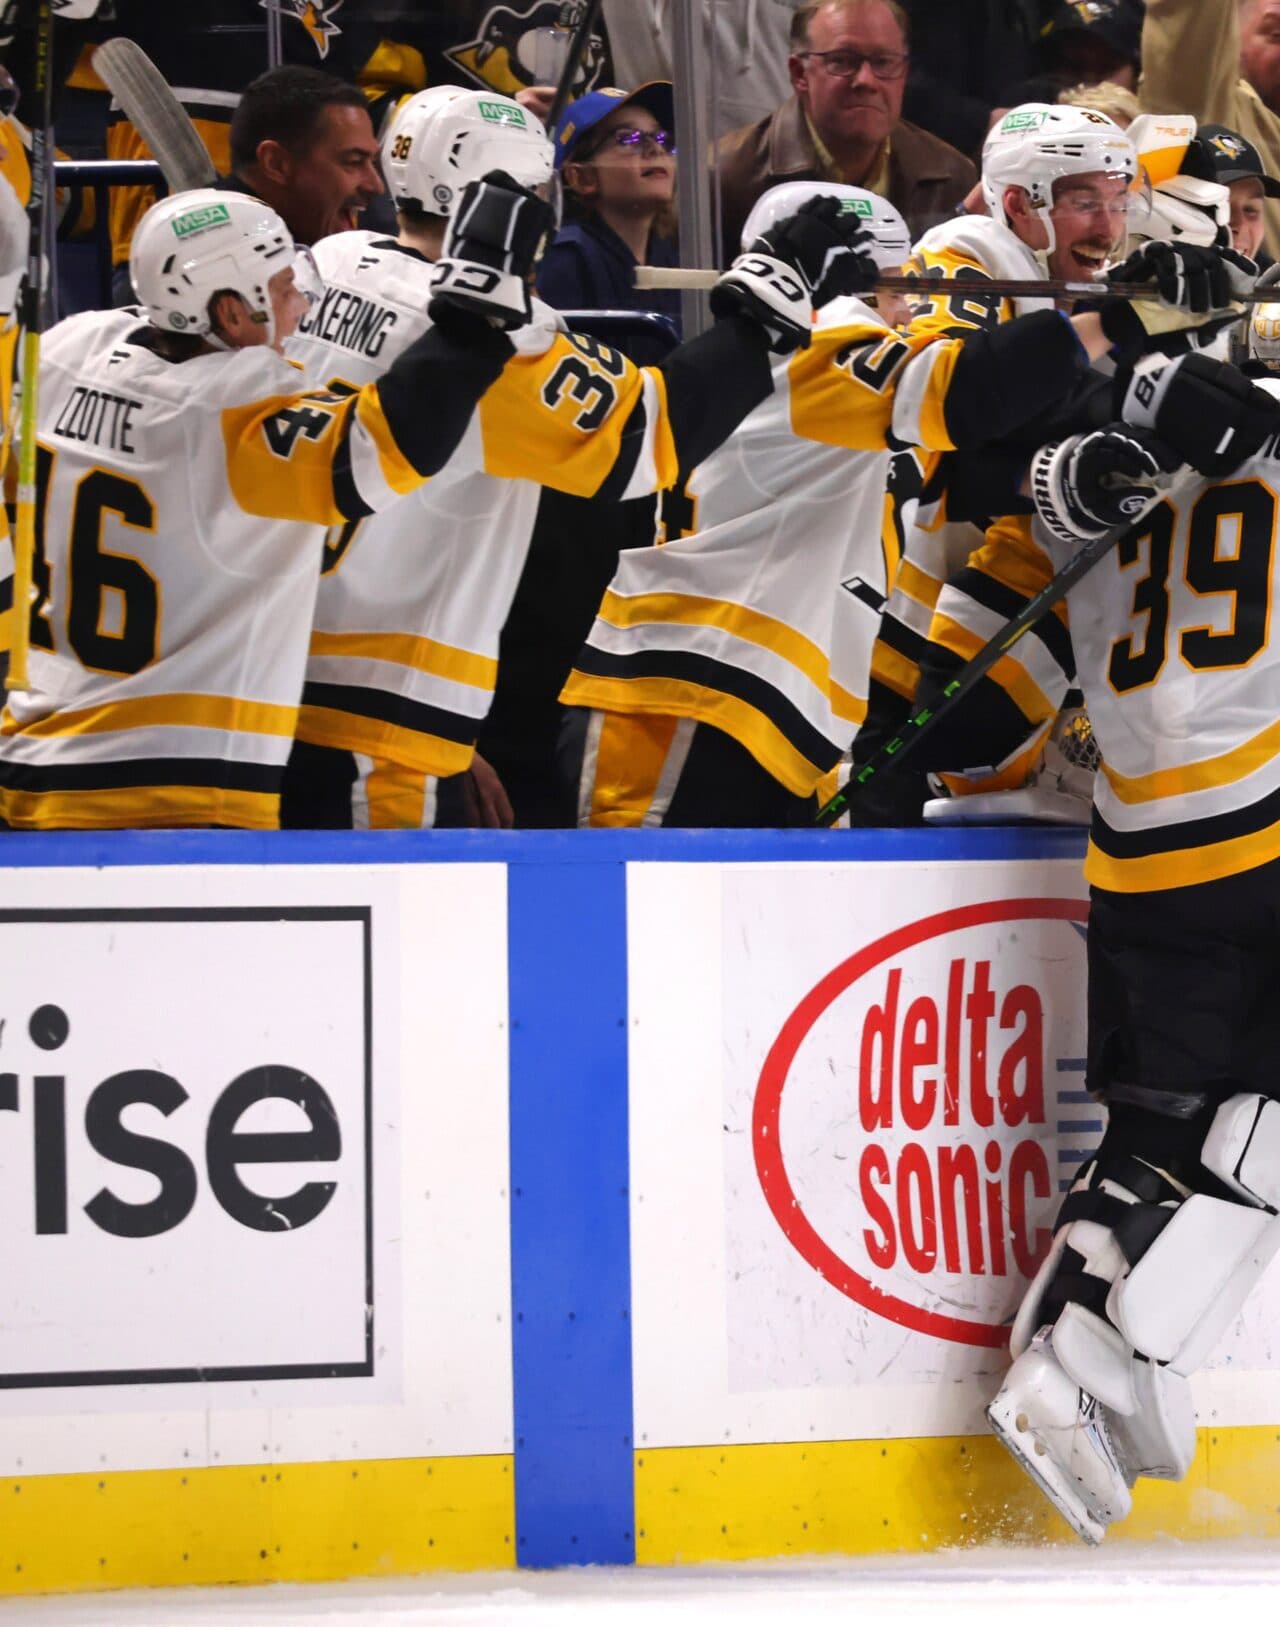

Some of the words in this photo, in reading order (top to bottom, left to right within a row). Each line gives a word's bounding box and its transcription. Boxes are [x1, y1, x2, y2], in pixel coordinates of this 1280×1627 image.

[481, 103, 526, 124] MSA
[1003, 113, 1045, 131] MSA
[391, 135, 412, 160] 38
[174, 206, 229, 233] MSA
[842, 200, 871, 215] SA
[543, 330, 624, 430] 38
[1106, 477, 1280, 696] 39
[858, 957, 1046, 1133] delta
[858, 1139, 1052, 1280] sonic
